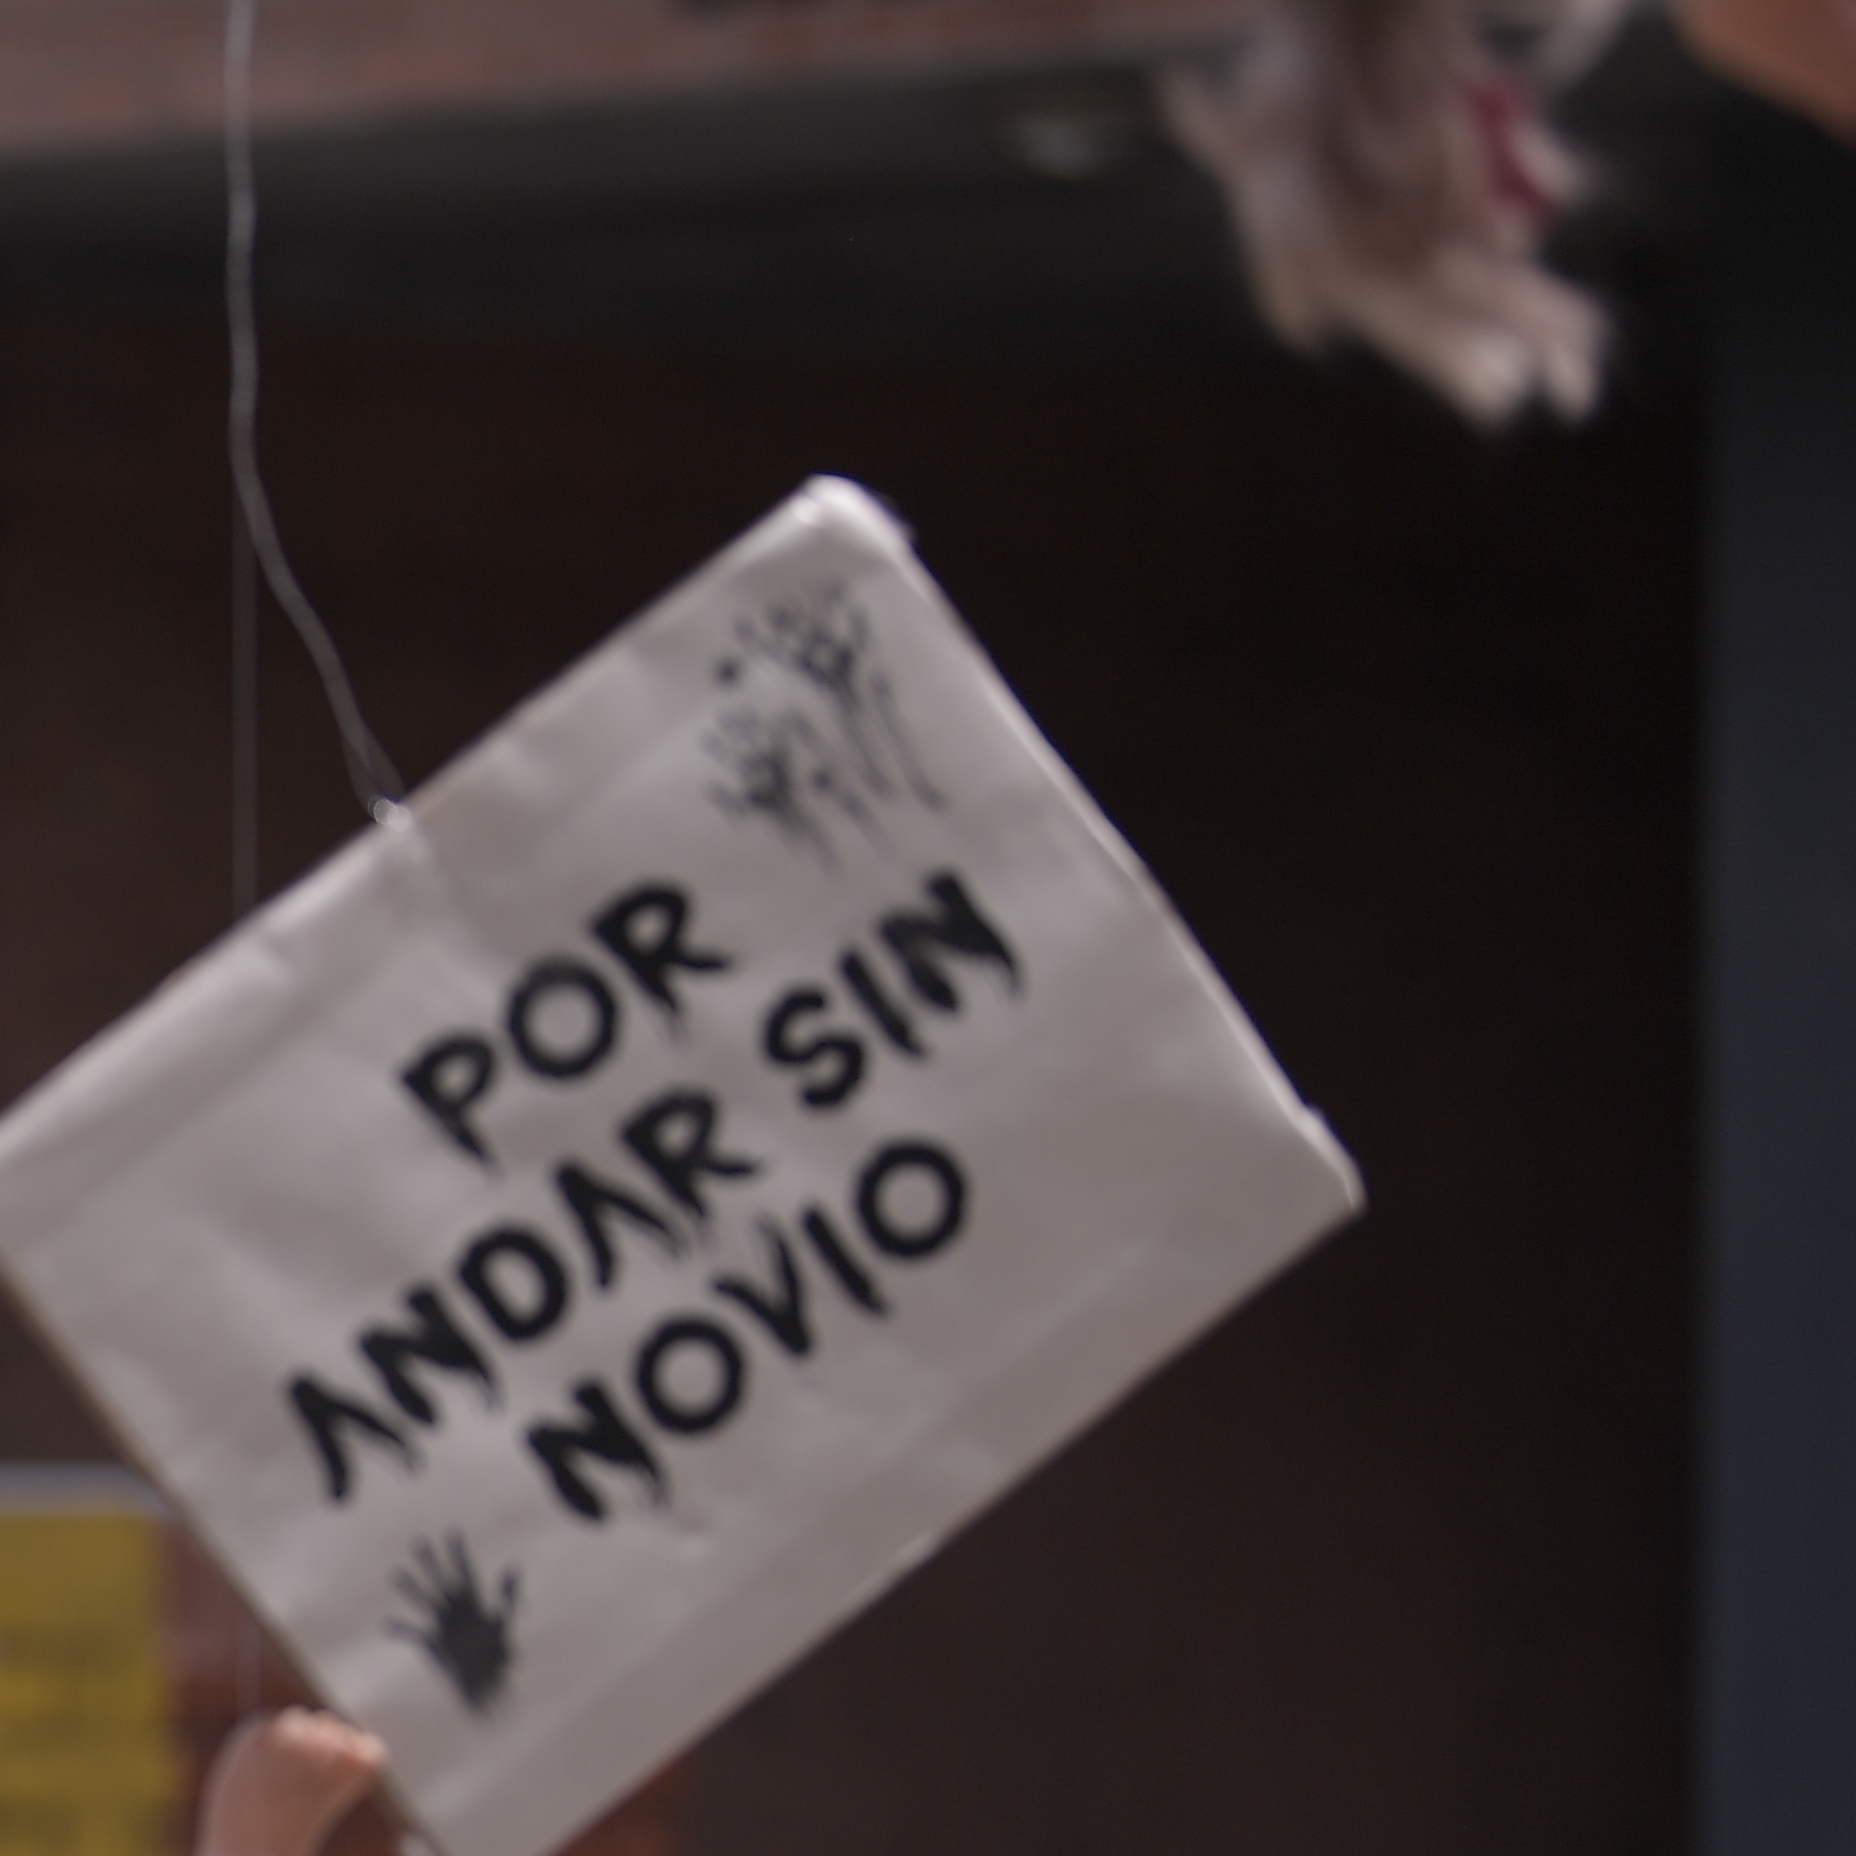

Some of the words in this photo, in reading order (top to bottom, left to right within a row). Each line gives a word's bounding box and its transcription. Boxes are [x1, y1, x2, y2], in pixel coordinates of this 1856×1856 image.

[284, 1087, 760, 1502] ANDAR
[760, 870, 1019, 1114] SIN
[399, 880, 733, 1165] POR
[524, 1137, 972, 1525] NOVIO
